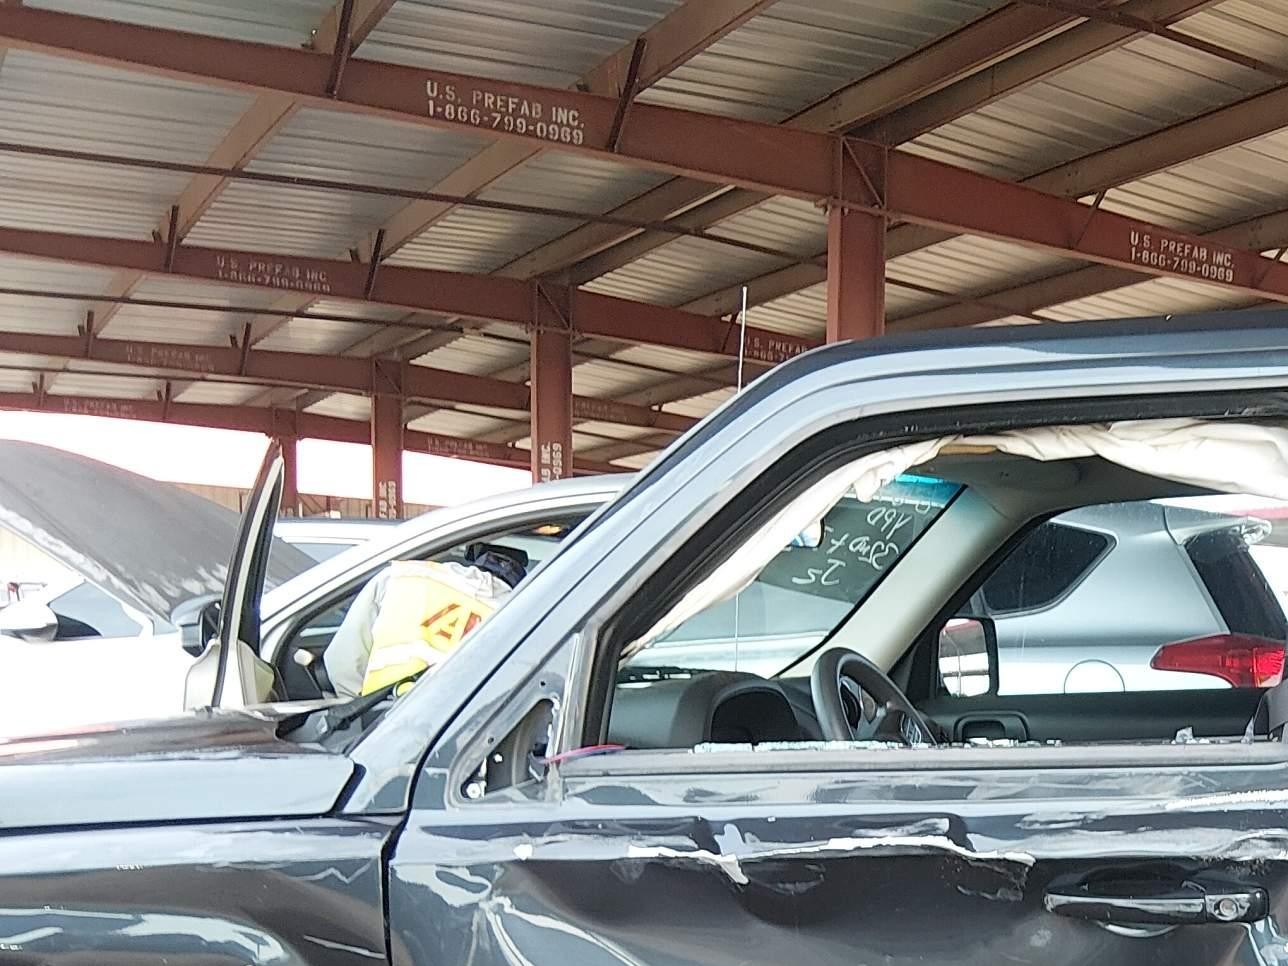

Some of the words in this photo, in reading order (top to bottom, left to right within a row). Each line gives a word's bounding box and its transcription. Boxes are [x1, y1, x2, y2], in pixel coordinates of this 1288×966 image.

[426, 80, 462, 103] U.S.
[472, 90, 543, 119] PREFAB
[551, 107, 585, 128] INC.
[428, 100, 584, 145] 1-866-799-0969
[1131, 246, 1233, 282] 1-866-799-0969
[1160, 239, 1207, 261] PREFAB
[1212, 251, 1235, 268] INC.
